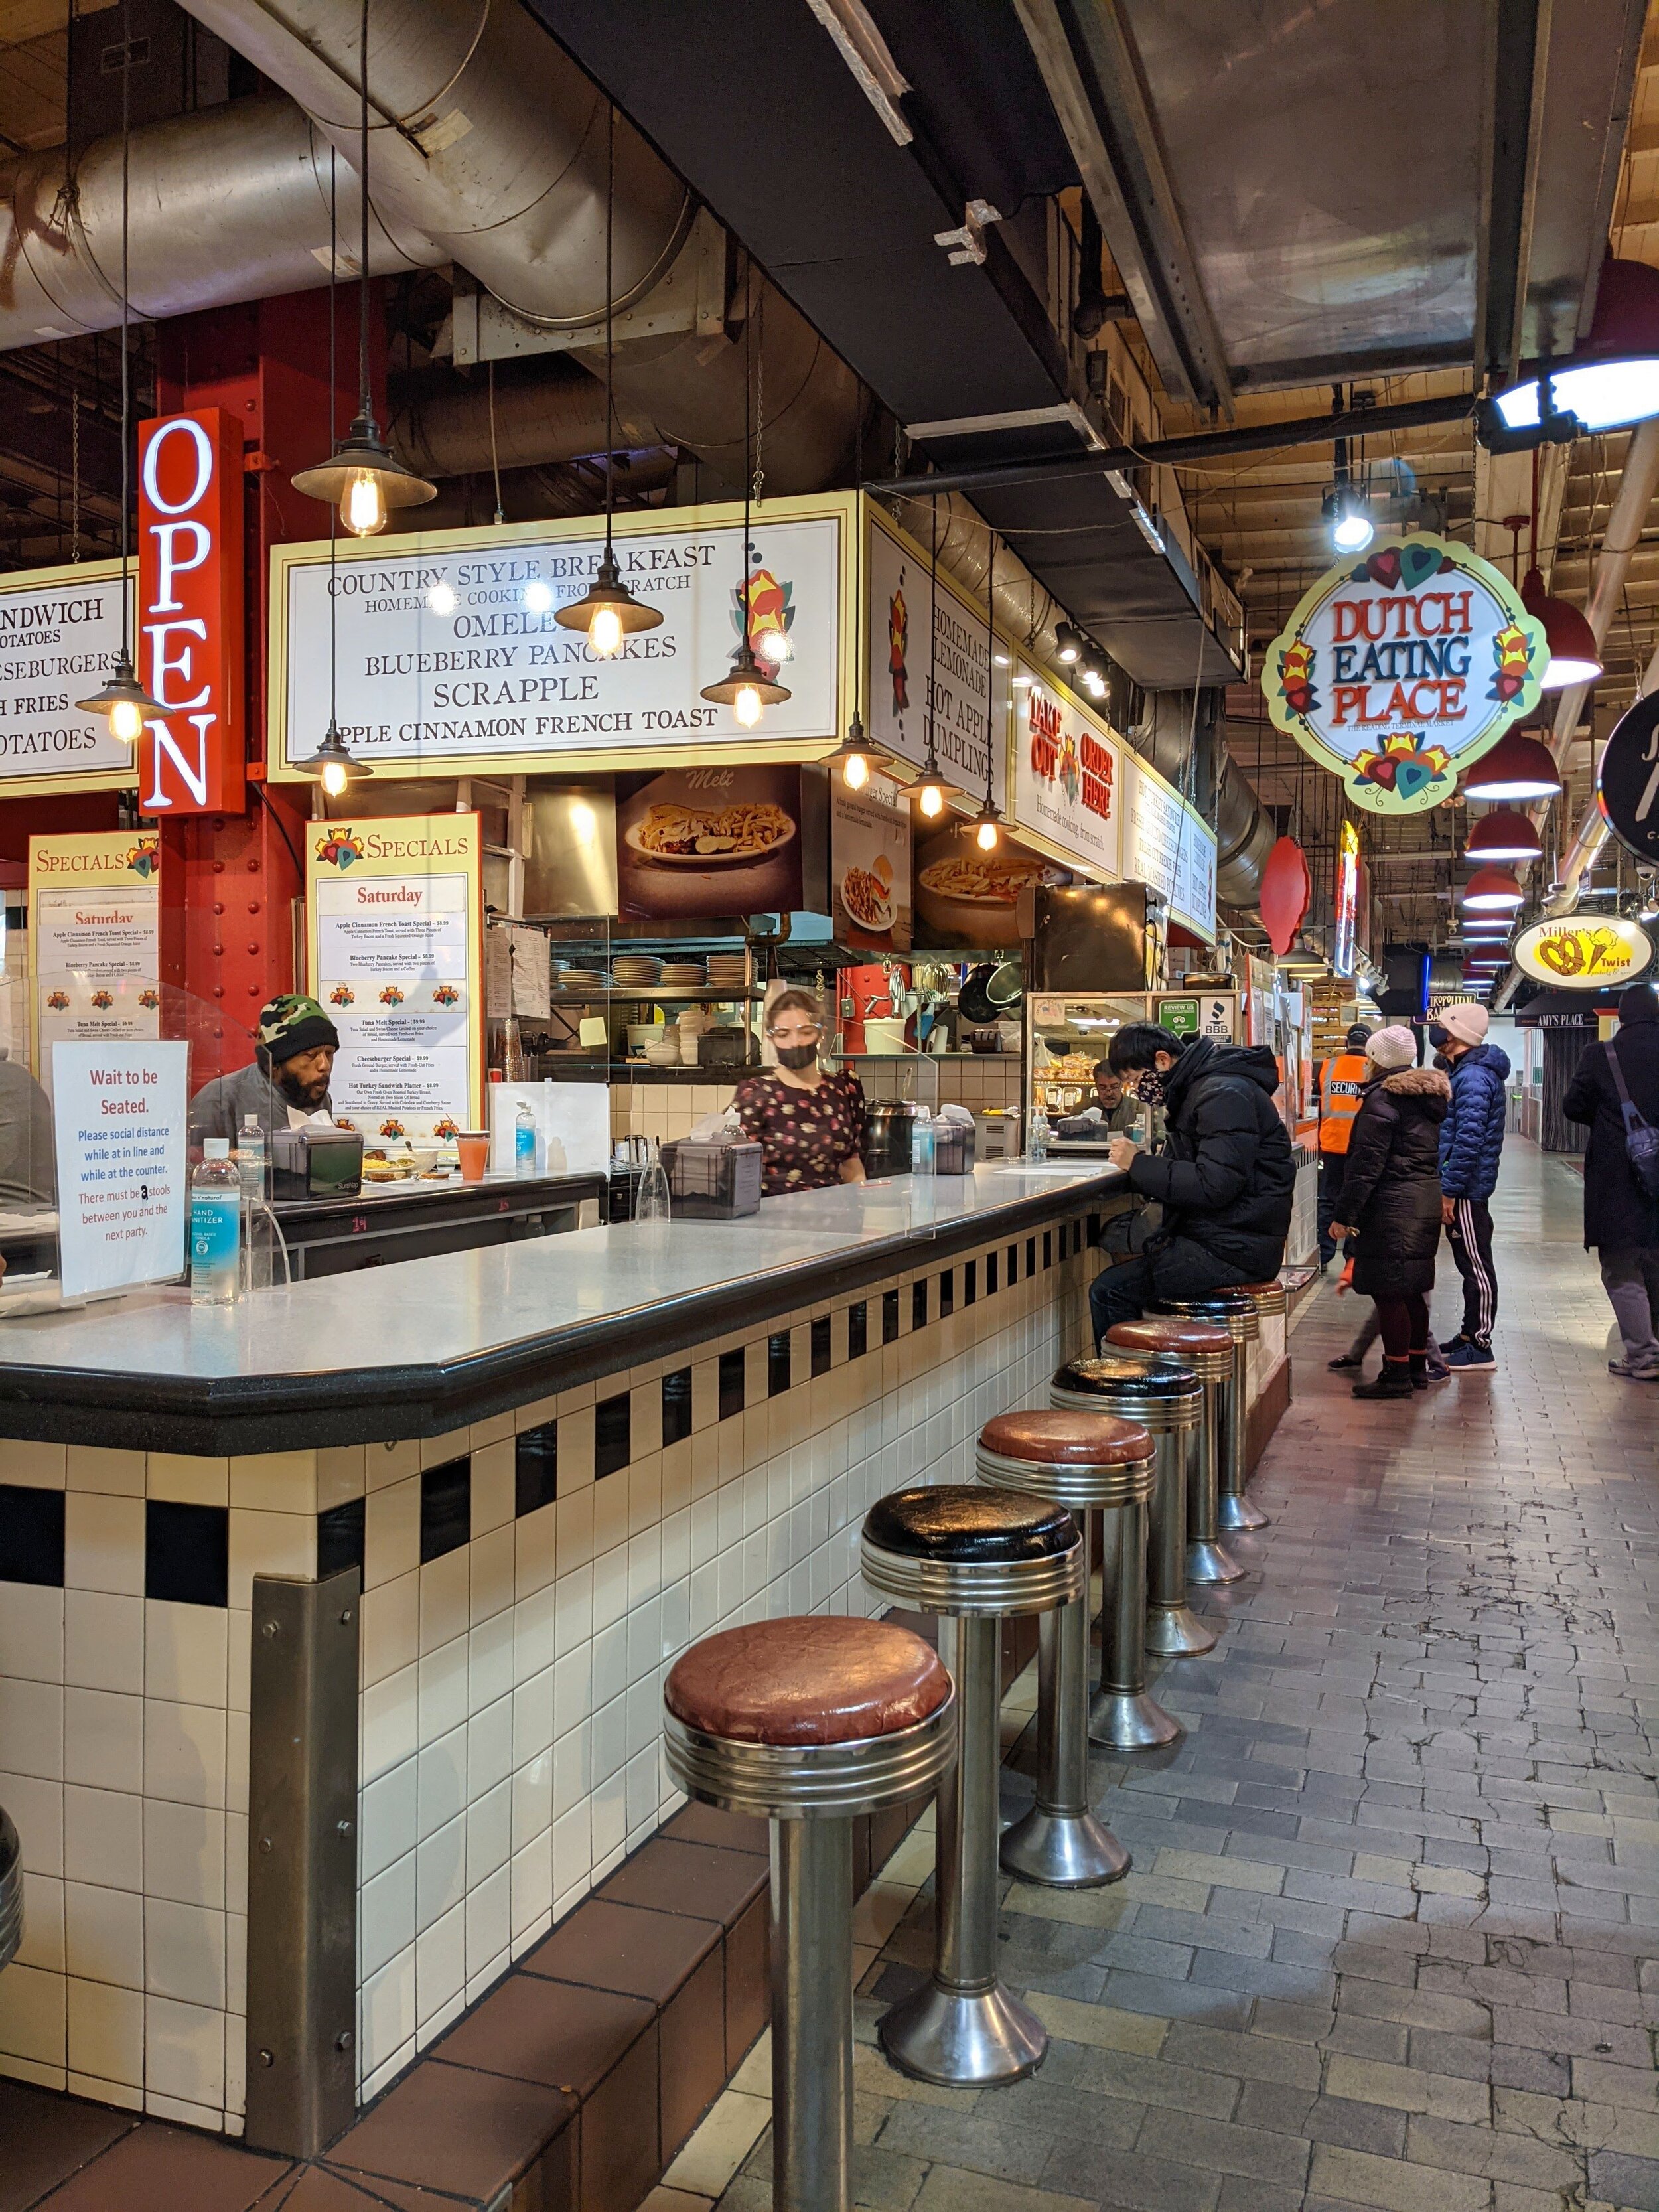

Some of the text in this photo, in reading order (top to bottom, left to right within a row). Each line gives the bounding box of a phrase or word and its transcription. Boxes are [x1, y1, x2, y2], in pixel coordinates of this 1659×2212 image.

[328, 545, 716, 596] COUNTRY STYLE BREAKFAST
[365, 593, 461, 613] HOMEME
[556, 583, 590, 598] FRO
[143, 419, 217, 808] OPEN
[453, 610, 569, 639] OMELE
[1333, 591, 1474, 642] DUTCH
[934, 605, 989, 672] HOMEMADE
[0, 651, 121, 681] SEBURGERS
[365, 646, 518, 676] BLUEBERRY
[934, 636, 987, 698] LEMONADE
[1333, 636, 1472, 683] EATING
[14, 694, 68, 715] FRIES
[433, 676, 599, 708] SCRAPPLE
[1332, 678, 1468, 723] PLACE
[338, 708, 719, 743] PPLE CINNAMON FRENCH TOAST
[925, 674, 993, 749] HOT APPLE
[1029, 686, 1062, 744] TAKE
[1391, 721, 1424, 729] TERMINAL
[923, 713, 994, 786] DUMPLINGS
[1031, 733, 1058, 781] OUT
[1080, 733, 1114, 786] ORDER
[685, 768, 735, 789] Melt
[879, 787, 897, 807] Special
[1081, 771, 1111, 820] HERE
[1037, 794, 1062, 826] Homemade
[1080, 823, 1090, 842] from
[358, 886, 423, 907] Saturday
[76, 910, 133, 924] Saturday
[1539, 926, 1591, 938] Miller's
[1601, 957, 1630, 967] Twist
[1427, 995, 1472, 1008] TROPOLITAN
[1538, 1014, 1583, 1026] AMY'S PLACE
[90, 1069, 158, 1085] Wait to be
[1331, 1082, 1358, 1094] SECURI
[101, 1098, 149, 1115] Seated.
[78, 1127, 169, 1141] Please social distance
[85, 1145, 165, 1161] while at in line and
[81, 1165, 168, 1181] while at the counter.
[78, 1193, 104, 1205] There
[106, 1190, 128, 1202] must
[130, 1188, 139, 1199] be
[149, 1185, 171, 1197] stools
[82, 1204, 167, 1224] between you and the
[106, 1226, 148, 1241] next party.
